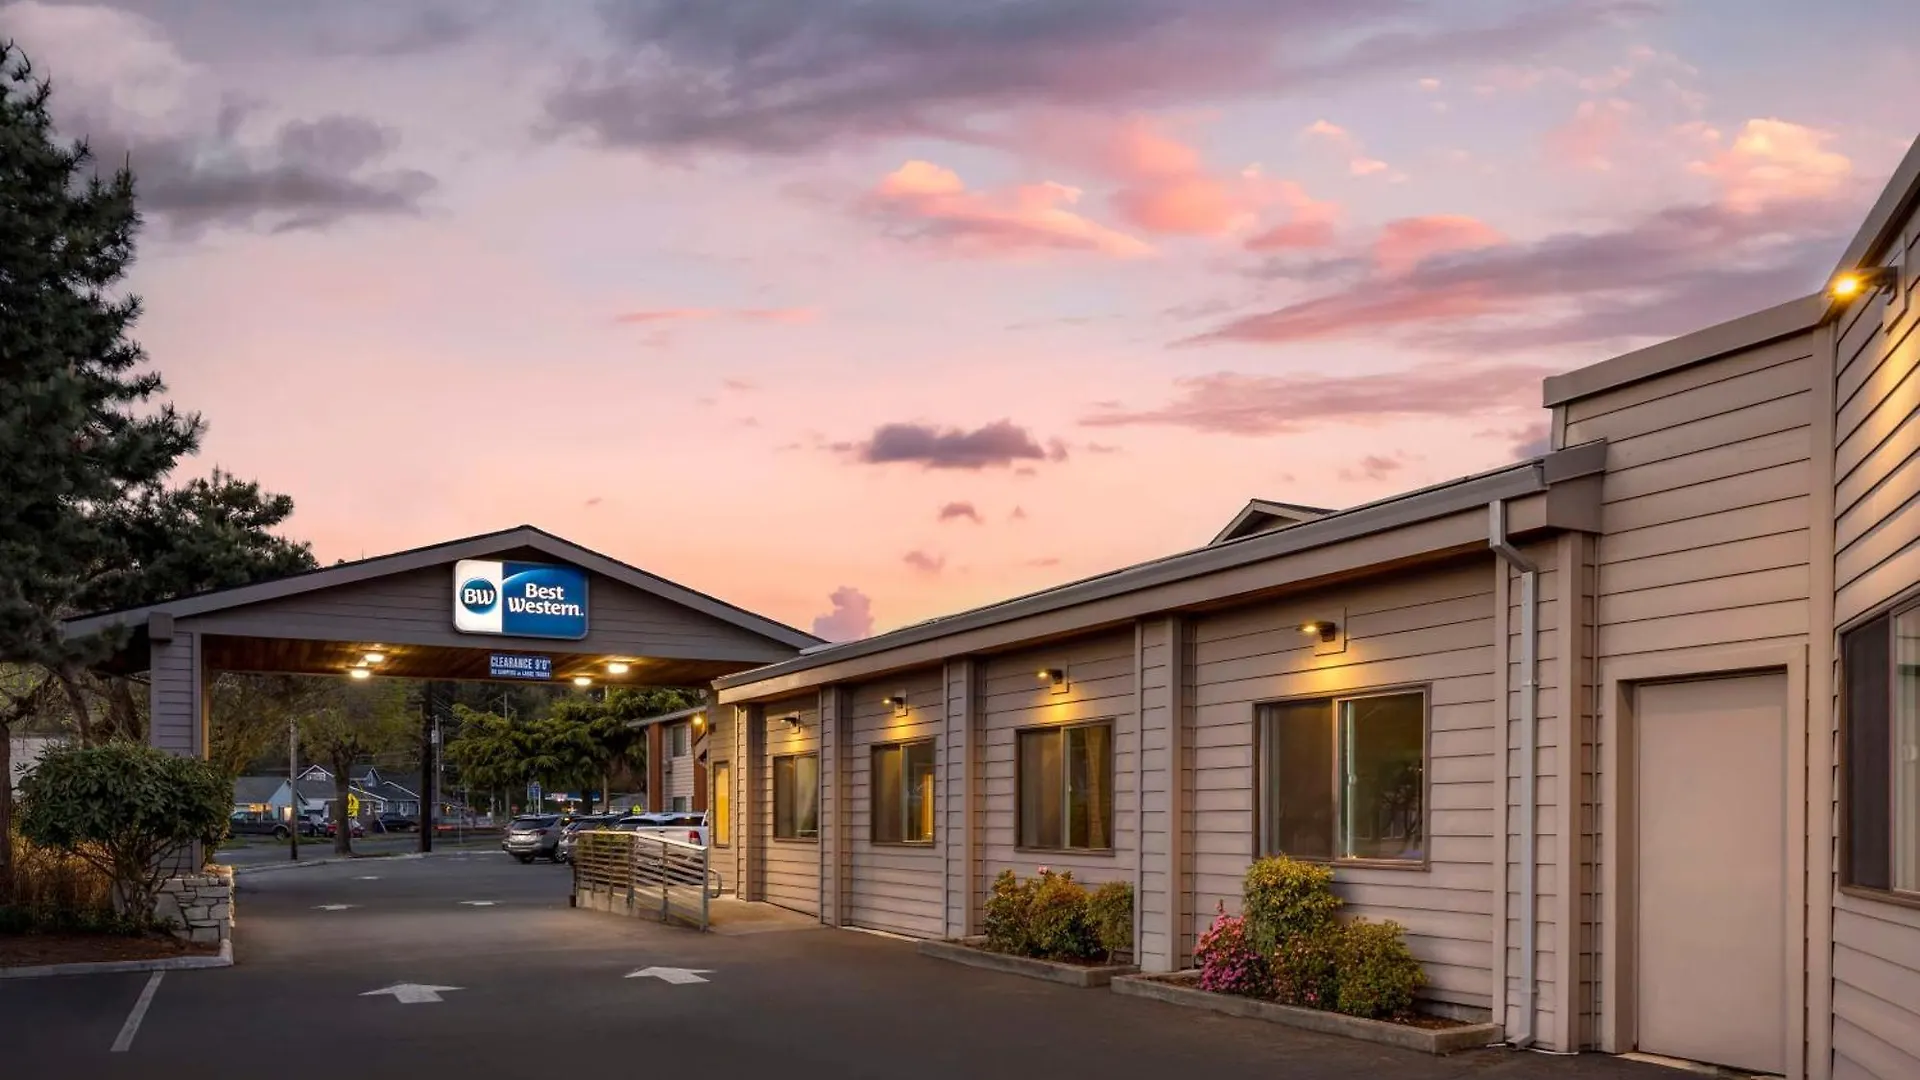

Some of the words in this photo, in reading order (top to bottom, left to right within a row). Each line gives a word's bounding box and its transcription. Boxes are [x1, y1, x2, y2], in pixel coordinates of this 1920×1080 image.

[464, 588, 495, 605] BW
[525, 582, 564, 600] Best
[491, 655, 533, 669] CLEARANCE
